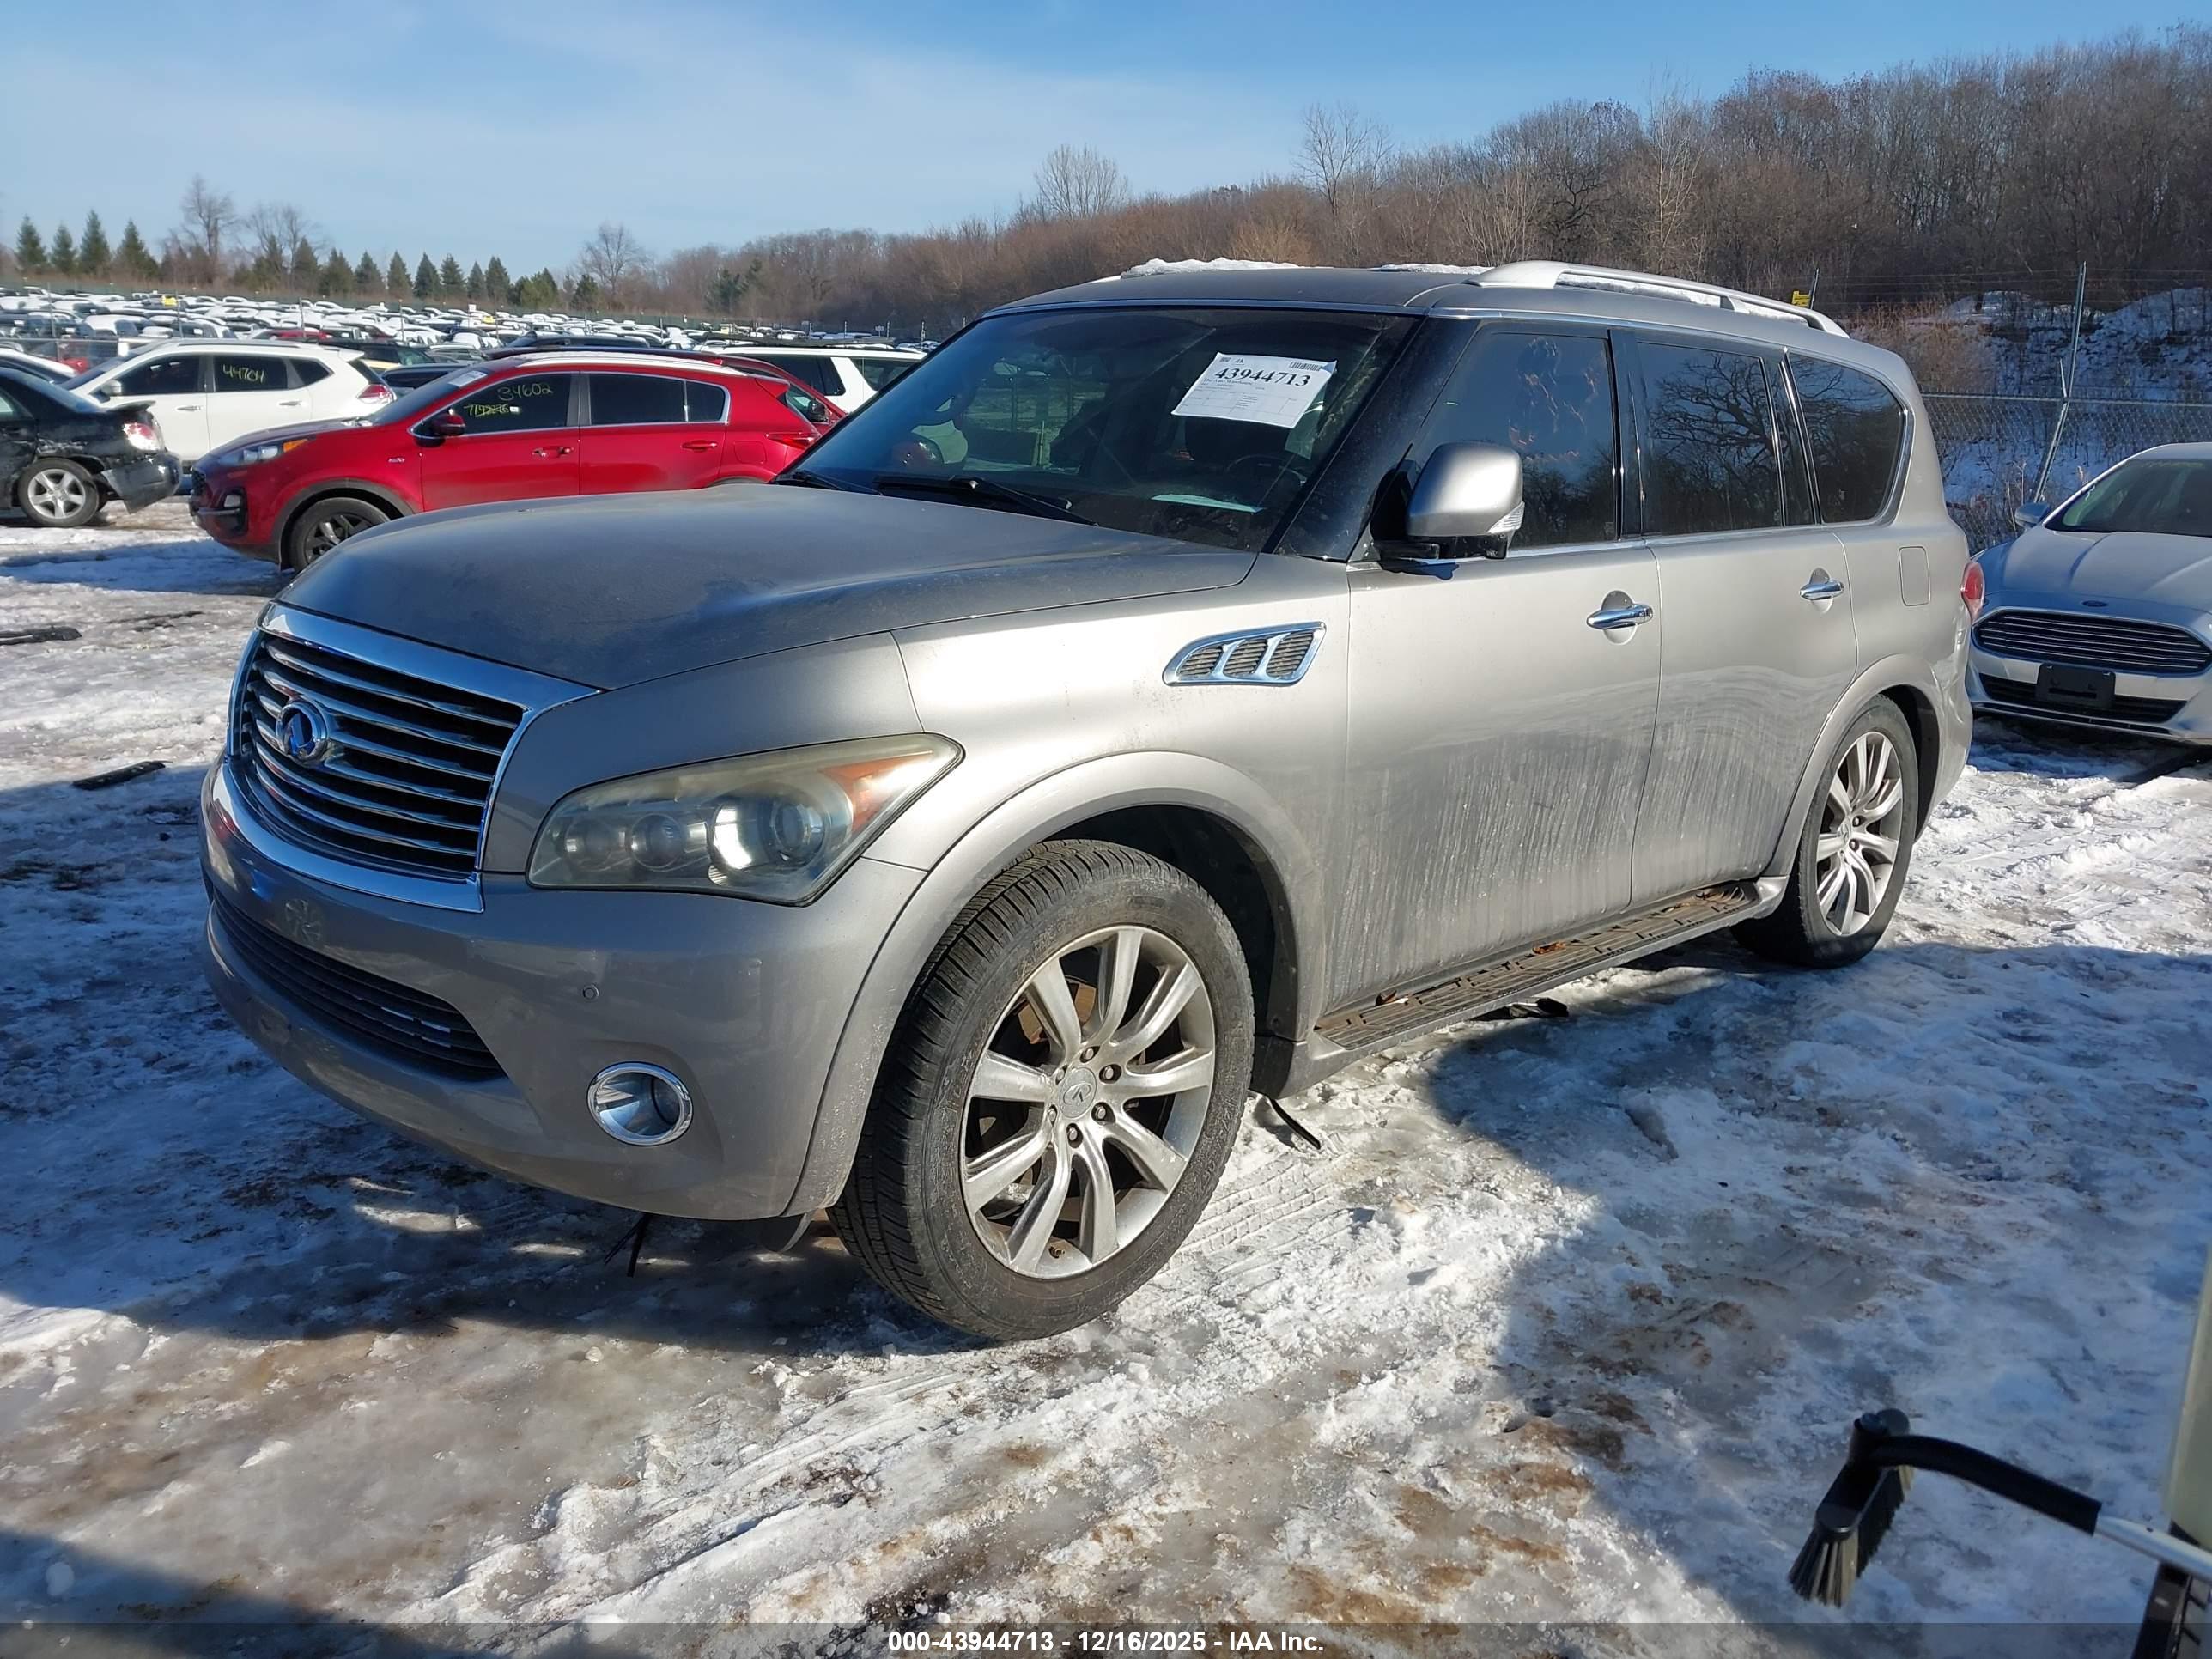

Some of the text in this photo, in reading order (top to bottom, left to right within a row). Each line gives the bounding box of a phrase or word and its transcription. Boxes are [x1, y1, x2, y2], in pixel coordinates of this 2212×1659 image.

[222, 363, 264, 384] 44704
[1215, 367, 1311, 386] 43944713
[498, 383, 554, 401] 34602
